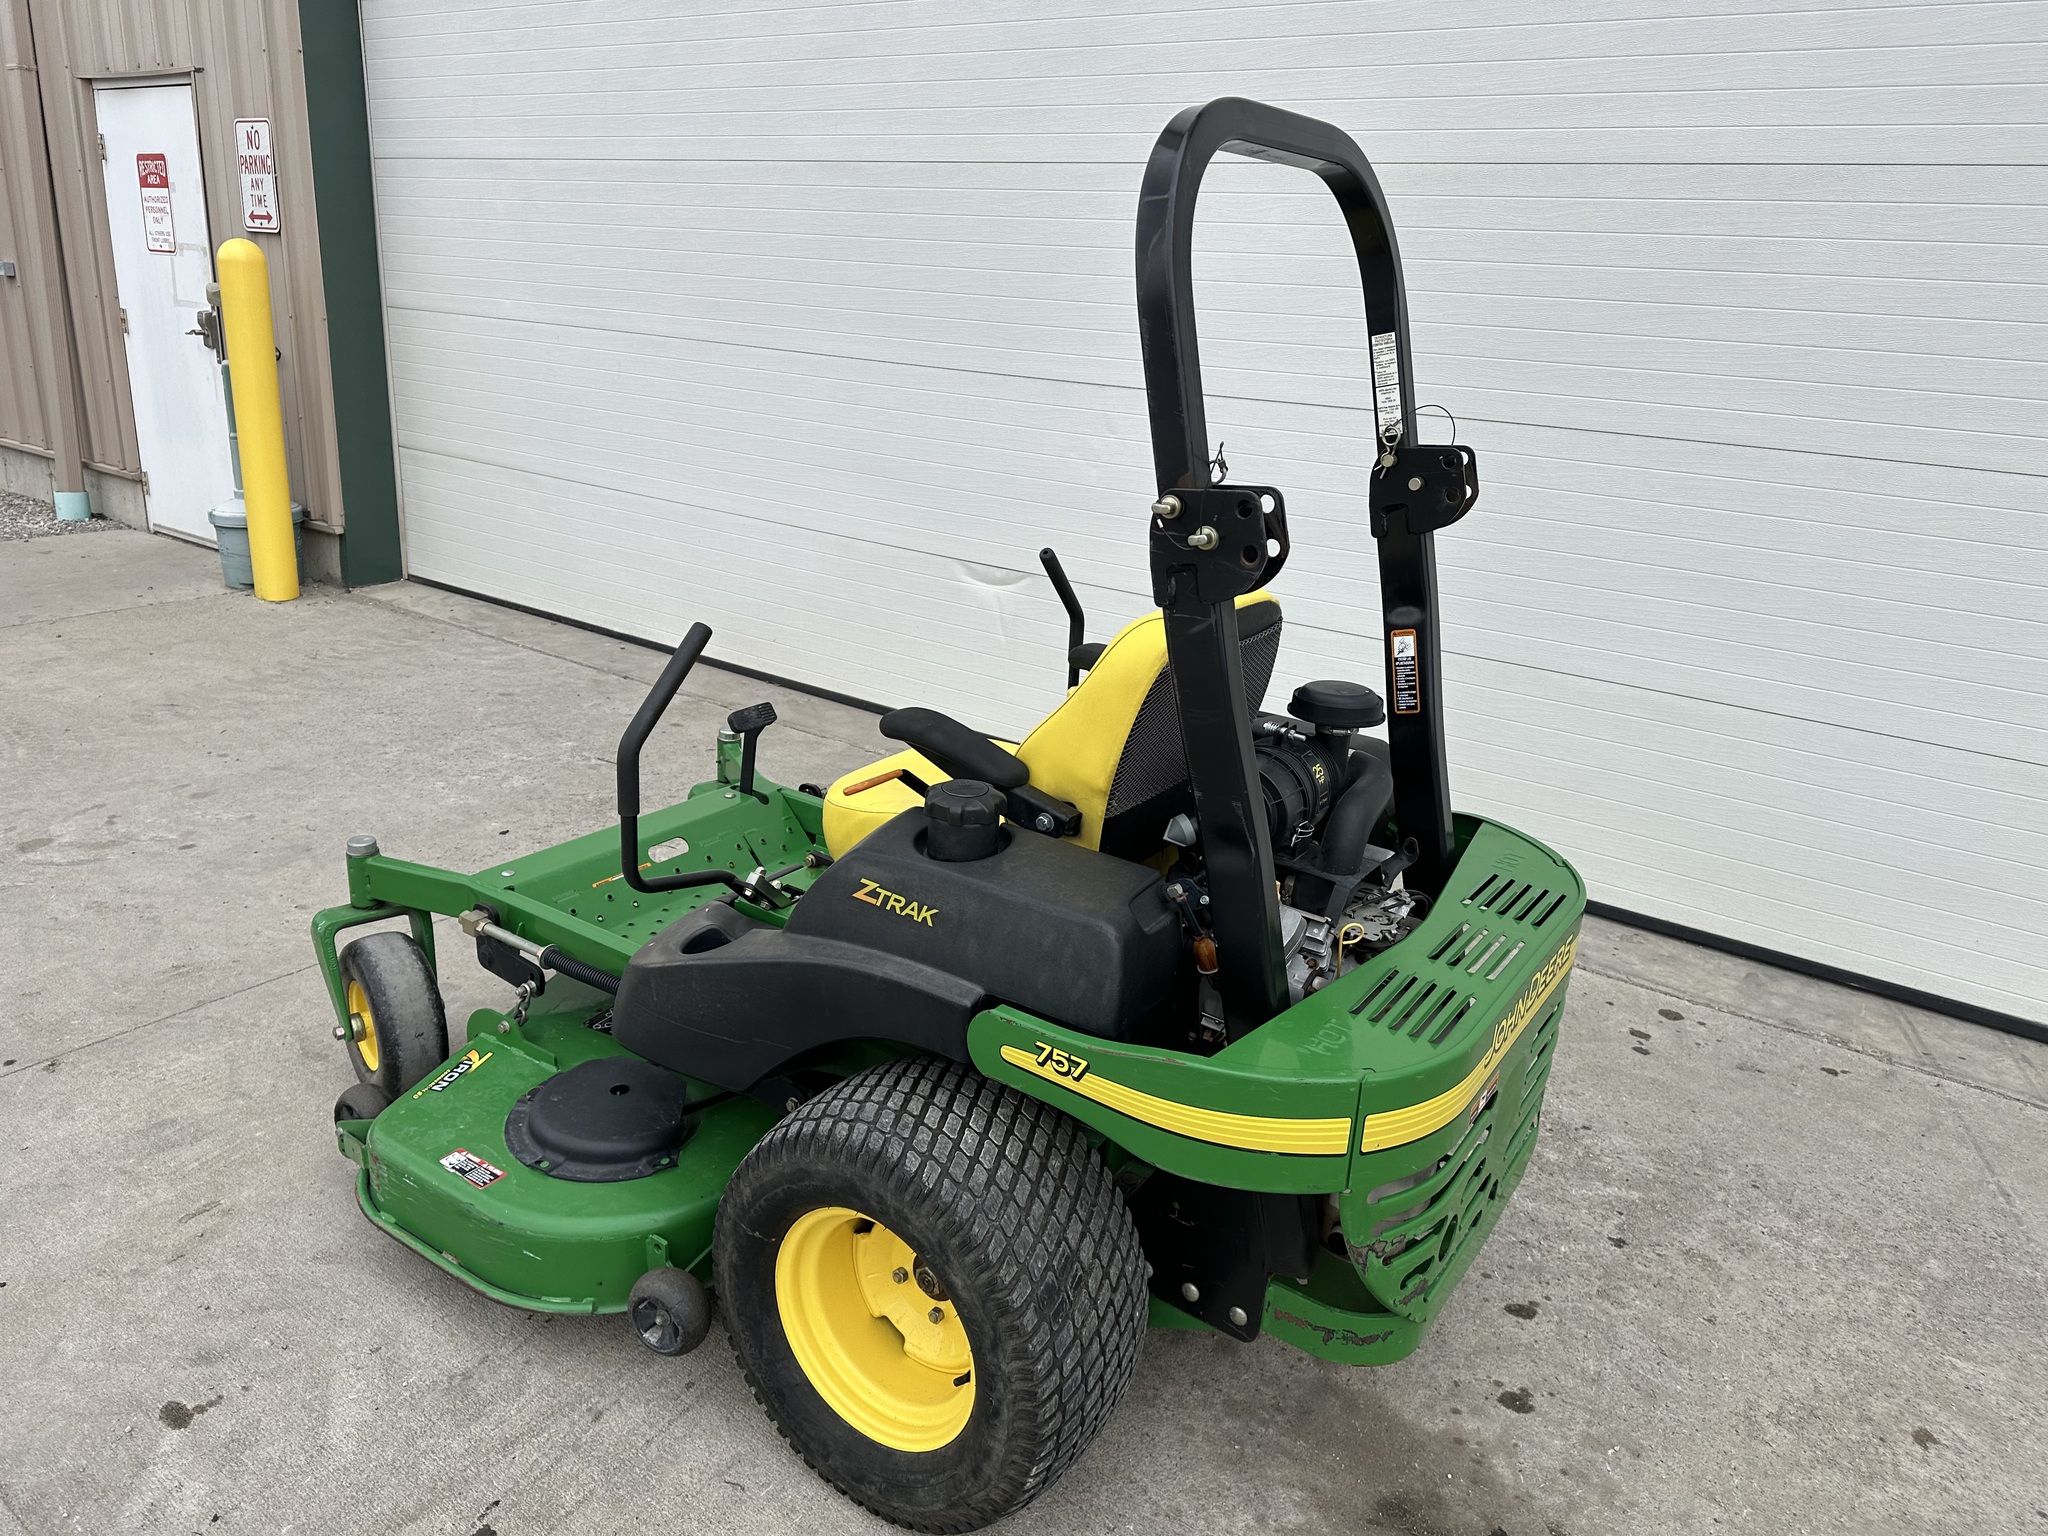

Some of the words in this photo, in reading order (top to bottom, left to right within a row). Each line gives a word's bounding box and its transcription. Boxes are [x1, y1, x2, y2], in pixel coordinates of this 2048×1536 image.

[246, 130, 260, 150] NO
[138, 160, 166, 177] RESTRICTED
[240, 155, 271, 175] PARKING
[147, 174, 161, 184] AREA
[251, 178, 264, 191] ANY
[144, 195, 168, 204] AUTHORIZED
[250, 194, 267, 208] TIME
[145, 205, 169, 214] PERSONNEL
[152, 216, 164, 224] ONLY
[1484, 989, 1530, 1069] JOHN
[1525, 933, 1574, 1014] DEERE
[1300, 1018, 1350, 1056] HOT
[1034, 1040, 1090, 1083] 757
